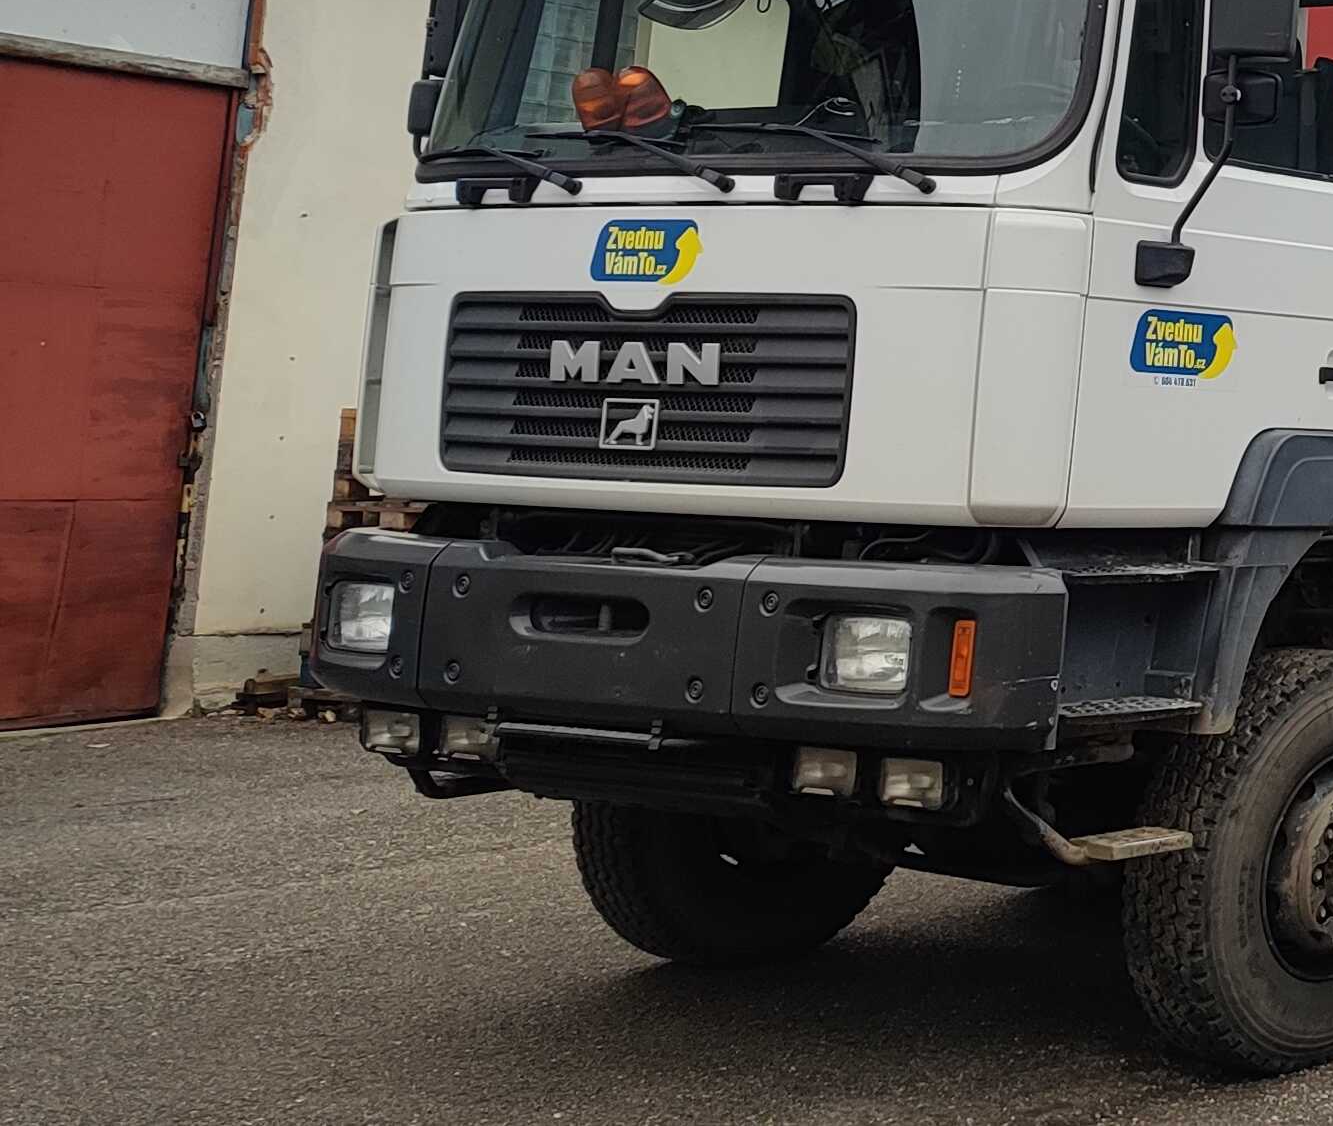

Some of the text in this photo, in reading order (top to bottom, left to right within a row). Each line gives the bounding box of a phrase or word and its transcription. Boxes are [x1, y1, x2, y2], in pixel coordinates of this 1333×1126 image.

[606, 226, 665, 250] Zvednu
[1146, 316, 1203, 344] Zvednu
[550, 340, 721, 386] MAN
